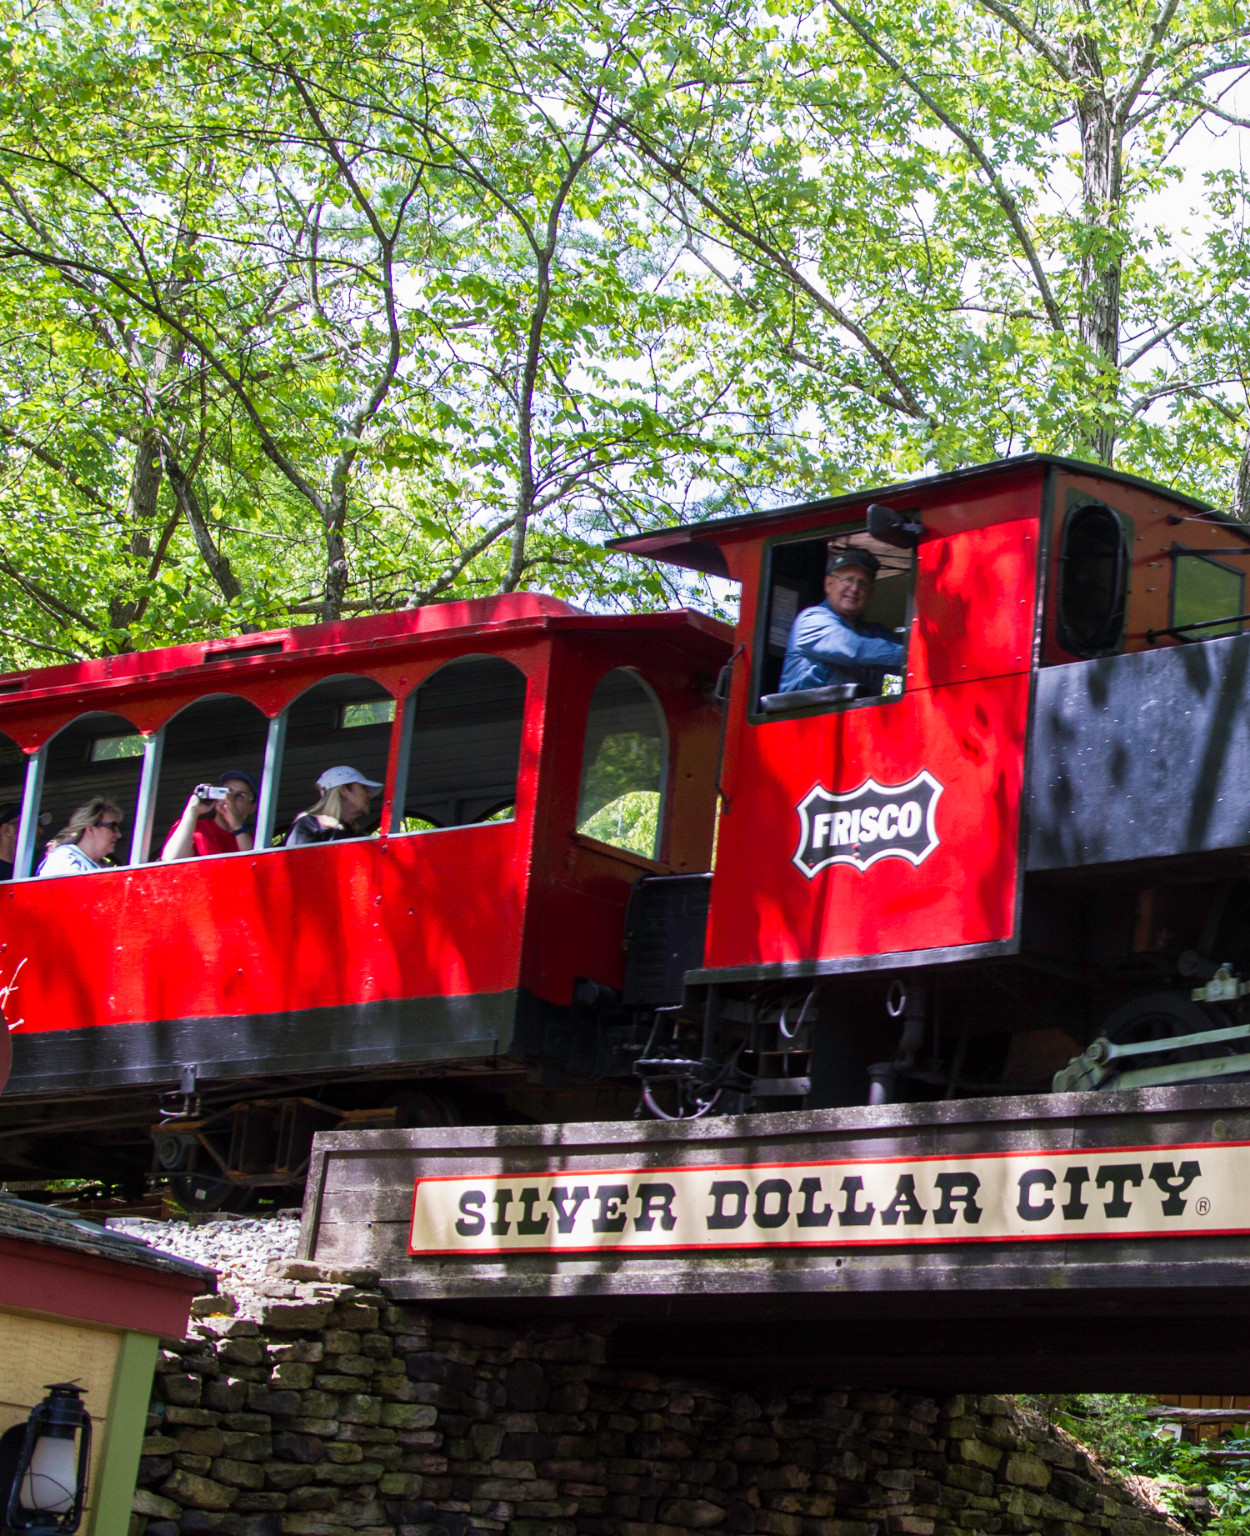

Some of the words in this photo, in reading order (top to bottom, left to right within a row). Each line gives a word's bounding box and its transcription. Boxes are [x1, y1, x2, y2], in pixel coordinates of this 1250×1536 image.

[811, 800, 923, 849] FRISCO
[455, 1182, 678, 1238] SILVER
[706, 1171, 983, 1230] DOLLAR
